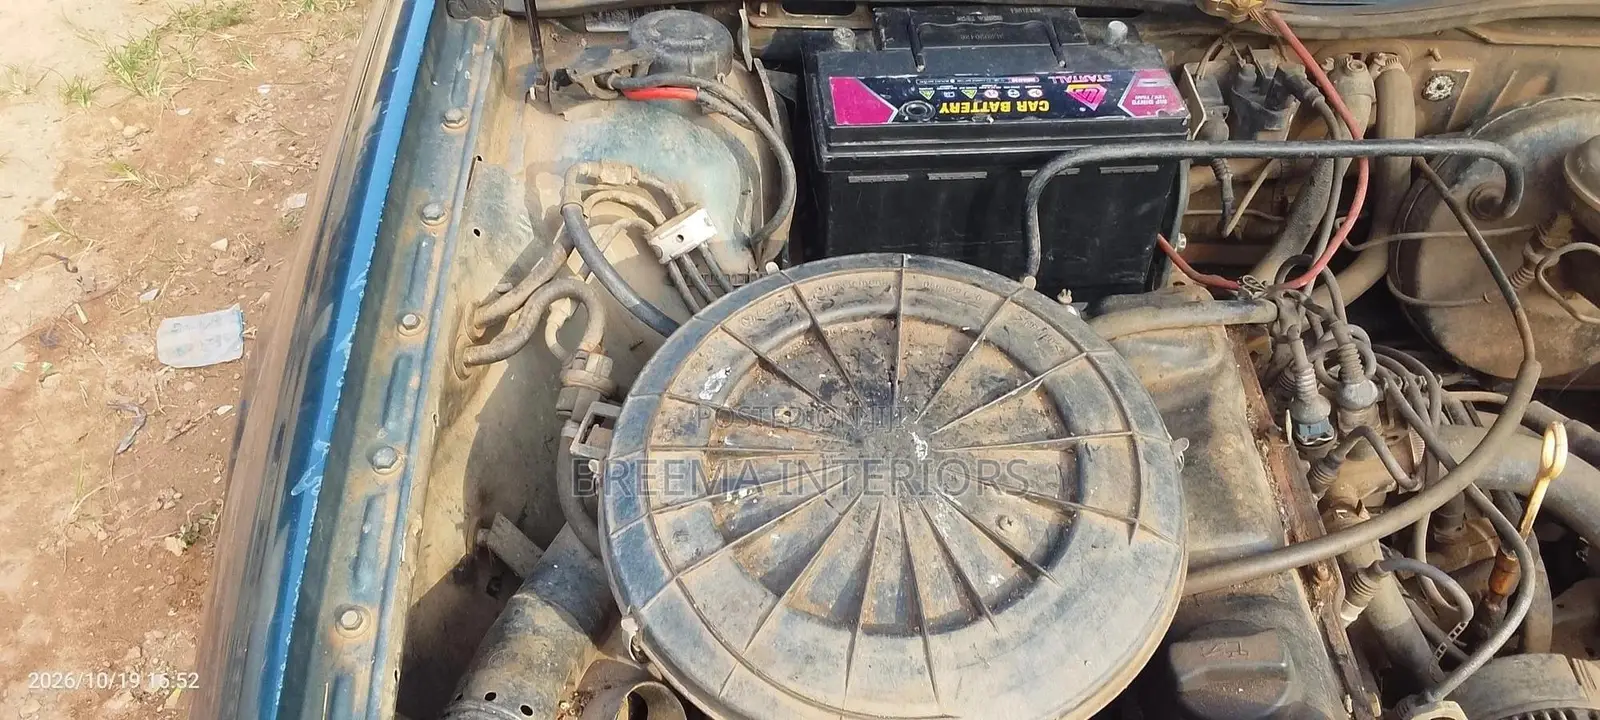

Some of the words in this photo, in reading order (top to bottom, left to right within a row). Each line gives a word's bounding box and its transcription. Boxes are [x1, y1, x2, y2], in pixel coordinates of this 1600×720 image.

[1048, 74, 1113, 84] STARTALL
[939, 101, 1012, 114] BATTERY
[1016, 100, 1050, 112] CAR
